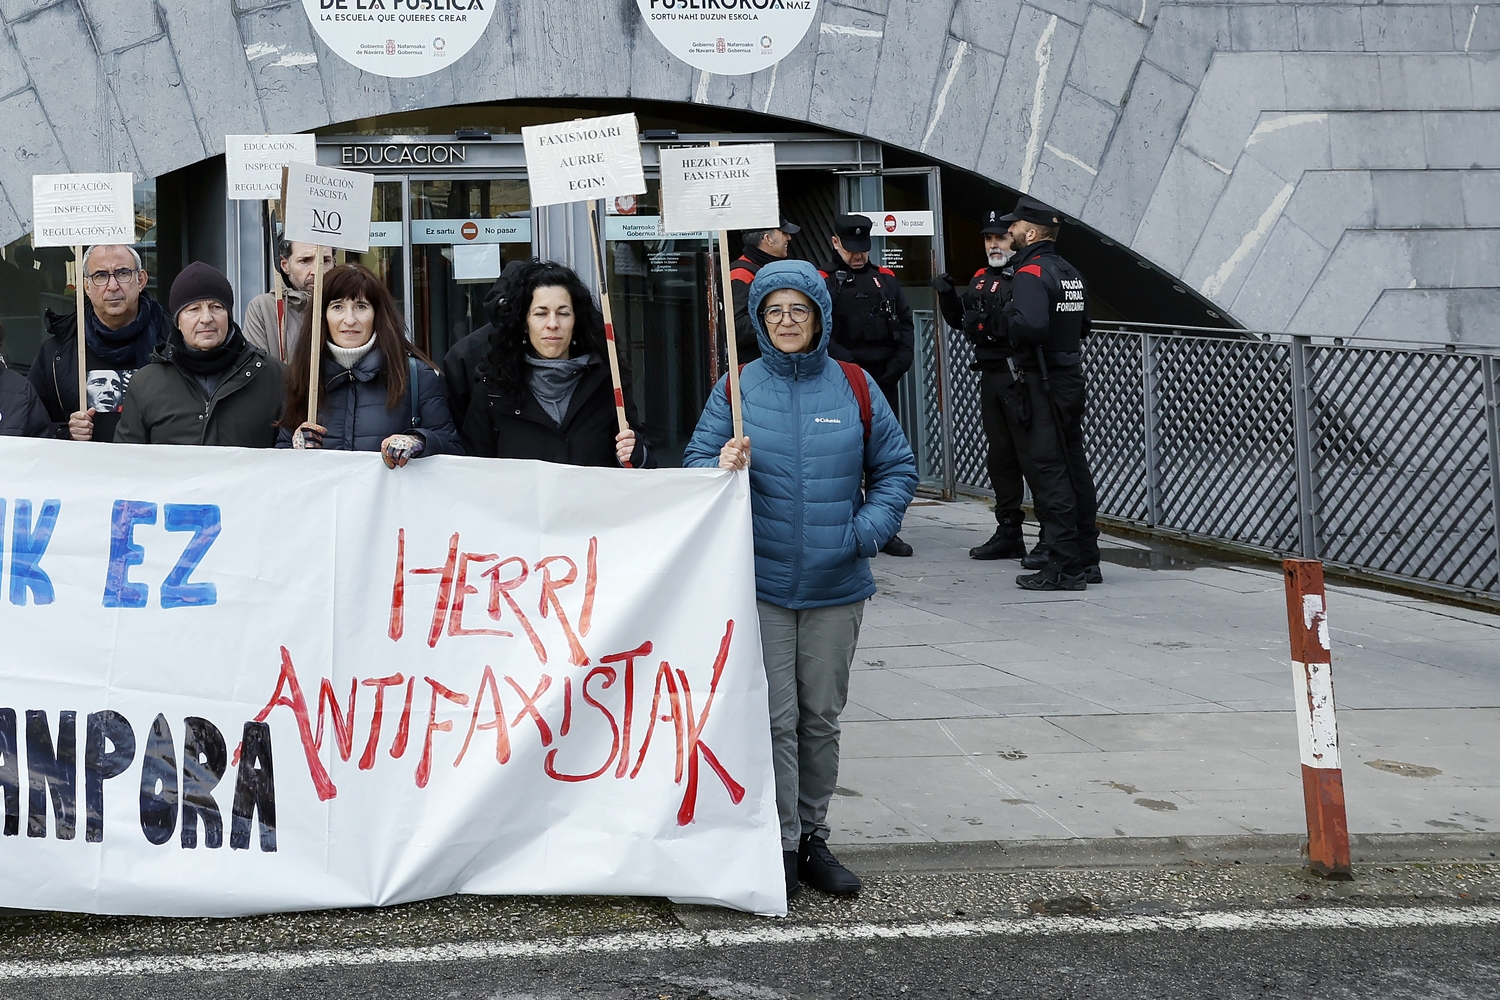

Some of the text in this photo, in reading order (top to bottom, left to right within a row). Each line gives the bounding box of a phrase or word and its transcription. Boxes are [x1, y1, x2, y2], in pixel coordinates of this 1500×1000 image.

[786, 1, 811, 10] NAIZ
[320, 13, 467, 23] LA ESCUELA QUE QUIERES CREAR
[651, 13, 759, 21] SORTU NAHI DUZUN ESKOLA
[538, 126, 621, 146] FAXISMOARI
[342, 145, 467, 164] EDUCACION
[559, 152, 605, 168] AURRE
[681, 156, 751, 168] HEZKUNTZA
[683, 169, 750, 181] FAXISTARIK
[568, 177, 606, 191] EGIN!
[309, 187, 348, 201] FASCISTA
[709, 193, 732, 207] EZ
[312, 208, 342, 232] NO
[496, 228, 517, 236] pasar
[1060, 277, 1084, 290] POLICÍA
[1064, 290, 1084, 301] FORAL
[102, 500, 221, 609] EZ
[387, 527, 598, 667] HERRI
[232, 619, 747, 826] ANTIFAXISTAK
